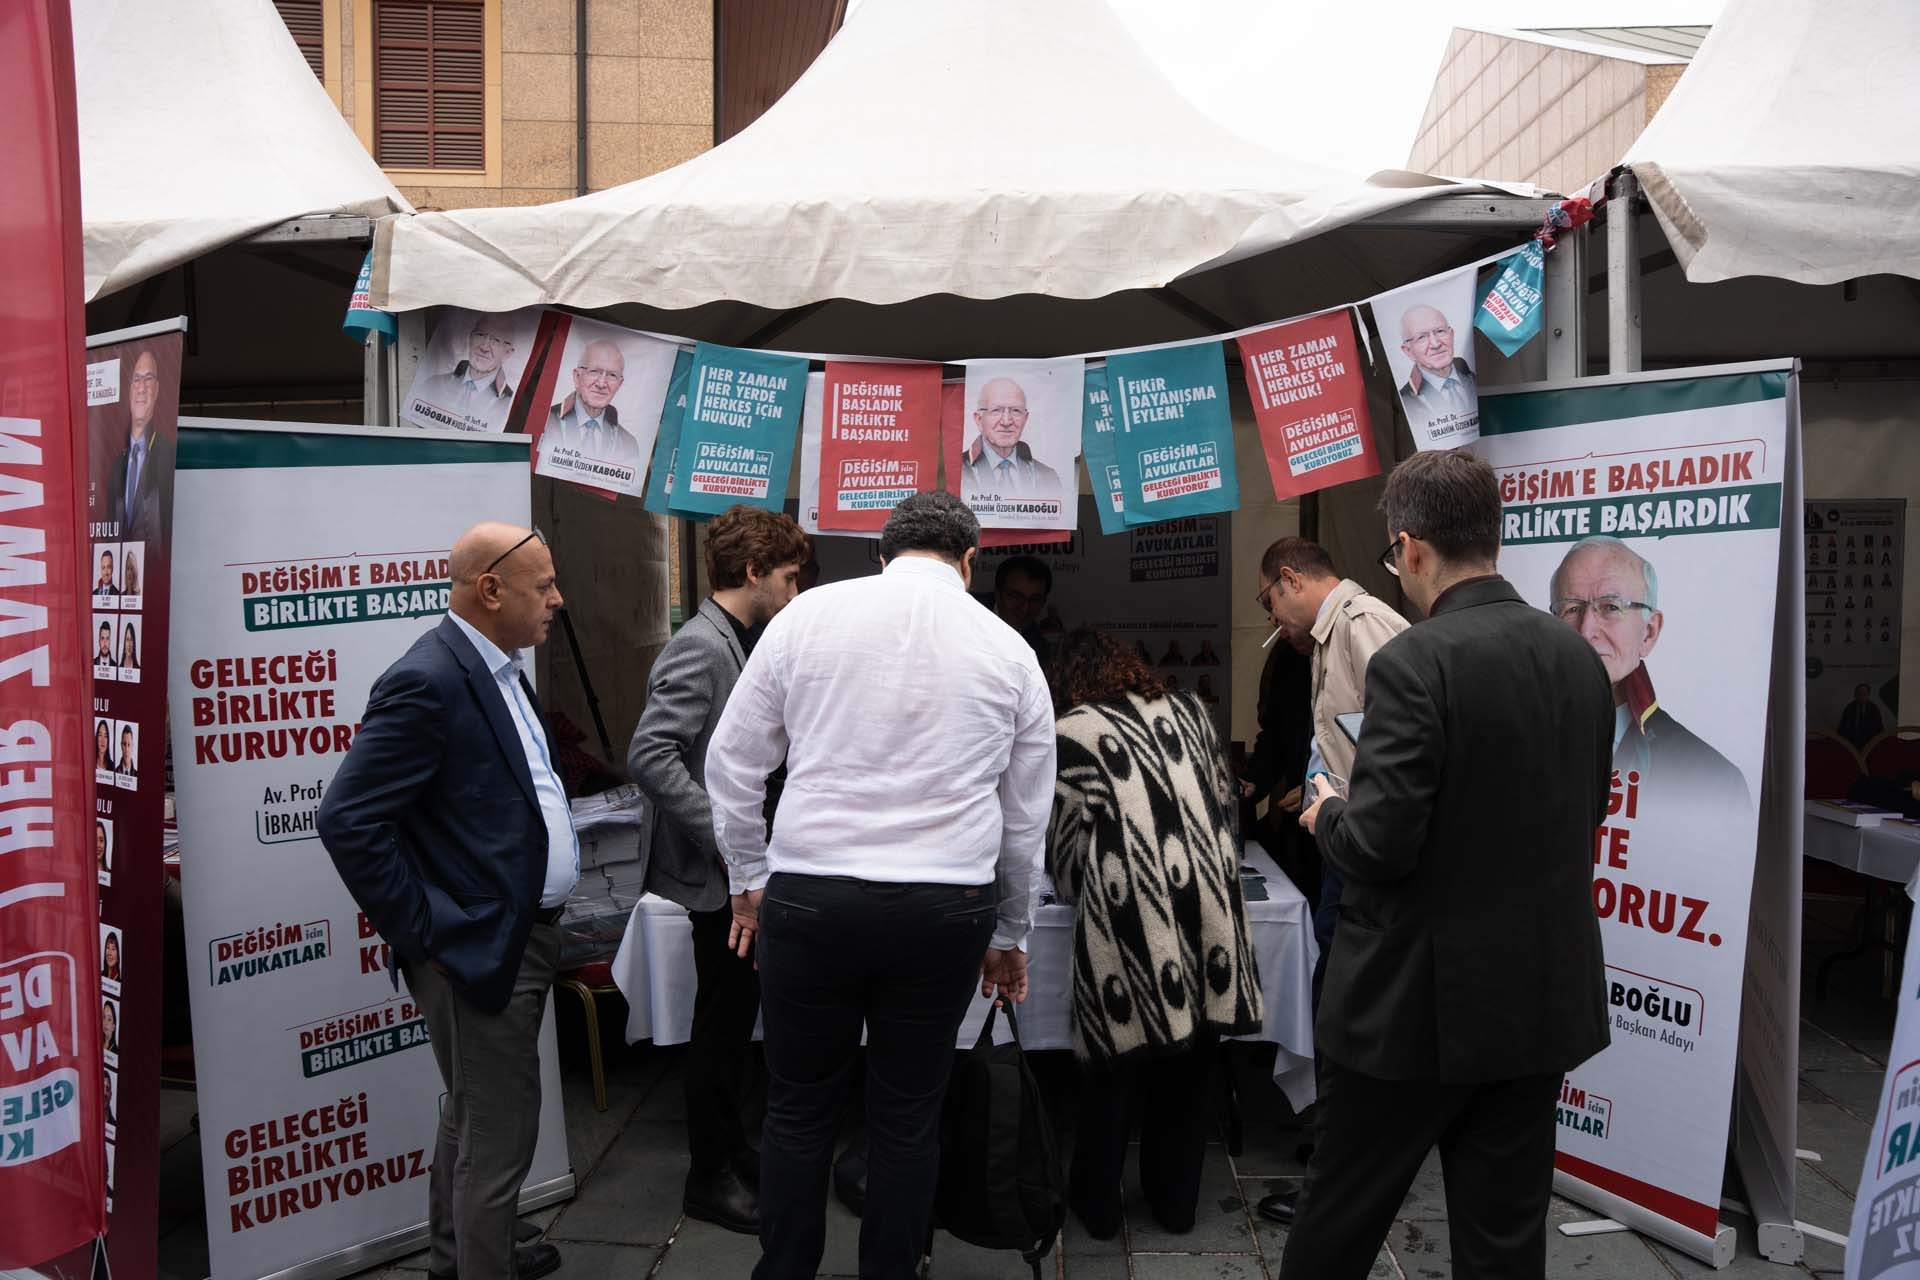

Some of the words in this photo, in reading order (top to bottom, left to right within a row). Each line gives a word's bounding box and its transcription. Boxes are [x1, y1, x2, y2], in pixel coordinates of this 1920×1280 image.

[1258, 349, 1285, 366] HER
[1288, 335, 1337, 358] ZAMAN
[1262, 363, 1289, 379] HER
[1291, 351, 1333, 371] YERDE
[708, 366, 733, 382] HER
[737, 371, 787, 391] ZAMAN
[842, 381, 903, 399] DEĞİŞİME
[1127, 377, 1166, 395] FİKİR
[1266, 372, 1316, 393] HERKES
[1319, 363, 1345, 382] İÇİN
[706, 381, 731, 396] HER
[735, 385, 776, 403] YERDE
[1130, 385, 1217, 410] DAYANIŞMA
[1270, 382, 1322, 408] HUKUK!
[703, 395, 752, 414] HERKES
[755, 402, 783, 420] İÇİN
[841, 398, 903, 414] BAŞLADIK
[1132, 403, 1185, 425] EYLEM!
[701, 409, 753, 429] HUKUK!
[841, 413, 896, 427] BİRLİKTE
[1285, 412, 1339, 439] DEĞİŞİM
[841, 428, 909, 444] BAŞARDIK!
[1288, 422, 1356, 453] AVUKATLAR
[700, 443, 755, 462] DEĞİŞİM
[1143, 444, 1199, 465] DEĞİŞİM
[1304, 448, 1354, 471] KURUYORUZ
[574, 459, 592, 472] ÖZDEN
[592, 463, 632, 480] KABOĞLU
[697, 459, 768, 475] AVUKATLAR
[844, 458, 899, 475] DEĞİŞİM
[1144, 455, 1215, 479] AVUKATLAR
[1500, 468, 1597, 505] ĞİŞİM'E
[1608, 451, 1754, 493] BAŞLADIK
[702, 483, 755, 495] KURUYORUZ
[842, 474, 914, 488] AVUKATLAR
[1156, 480, 1209, 499] KURUYORUZ
[851, 499, 897, 509] KURUYORU
[996, 502, 1016, 513] ÖZDEN
[1016, 502, 1058, 514] KABOĞLU
[1501, 506, 1591, 540] RLİKTE
[1600, 493, 1753, 535] BAŞARDIK
[89, 521, 120, 538] URULU
[241, 564, 361, 595] DEĞİŞİM'E
[369, 558, 450, 586] BAŞLAD
[254, 595, 359, 627] BİRLİKTE
[366, 588, 450, 617] BAŞARD
[190, 649, 337, 690] GELECEĞİ
[192, 687, 335, 727] BİRLİKTE
[194, 722, 362, 765] KURUYOR
[263, 787, 288, 805] Av.
[290, 779, 323, 802] Prof
[263, 805, 319, 836] İBRAHİ
[1592, 877, 1722, 947] ORUZ.
[217, 922, 303, 963] DEĞİŞİM
[305, 927, 324, 941] için
[217, 942, 327, 986] AVUKATLAR
[1609, 981, 1692, 1027] BOĞLU
[300, 1006, 395, 1051] DEĞİŞİM'E
[1616, 1014, 1656, 1040] Başkan
[1660, 1030, 1694, 1053] Adayı
[309, 1031, 394, 1074] BİRLİKTE
[1587, 1100, 1605, 1115] için
[225, 1092, 369, 1160] GELECEĞİ
[1555, 1106, 1605, 1139] ATLAR
[227, 1131, 369, 1198] BİRLİKTE
